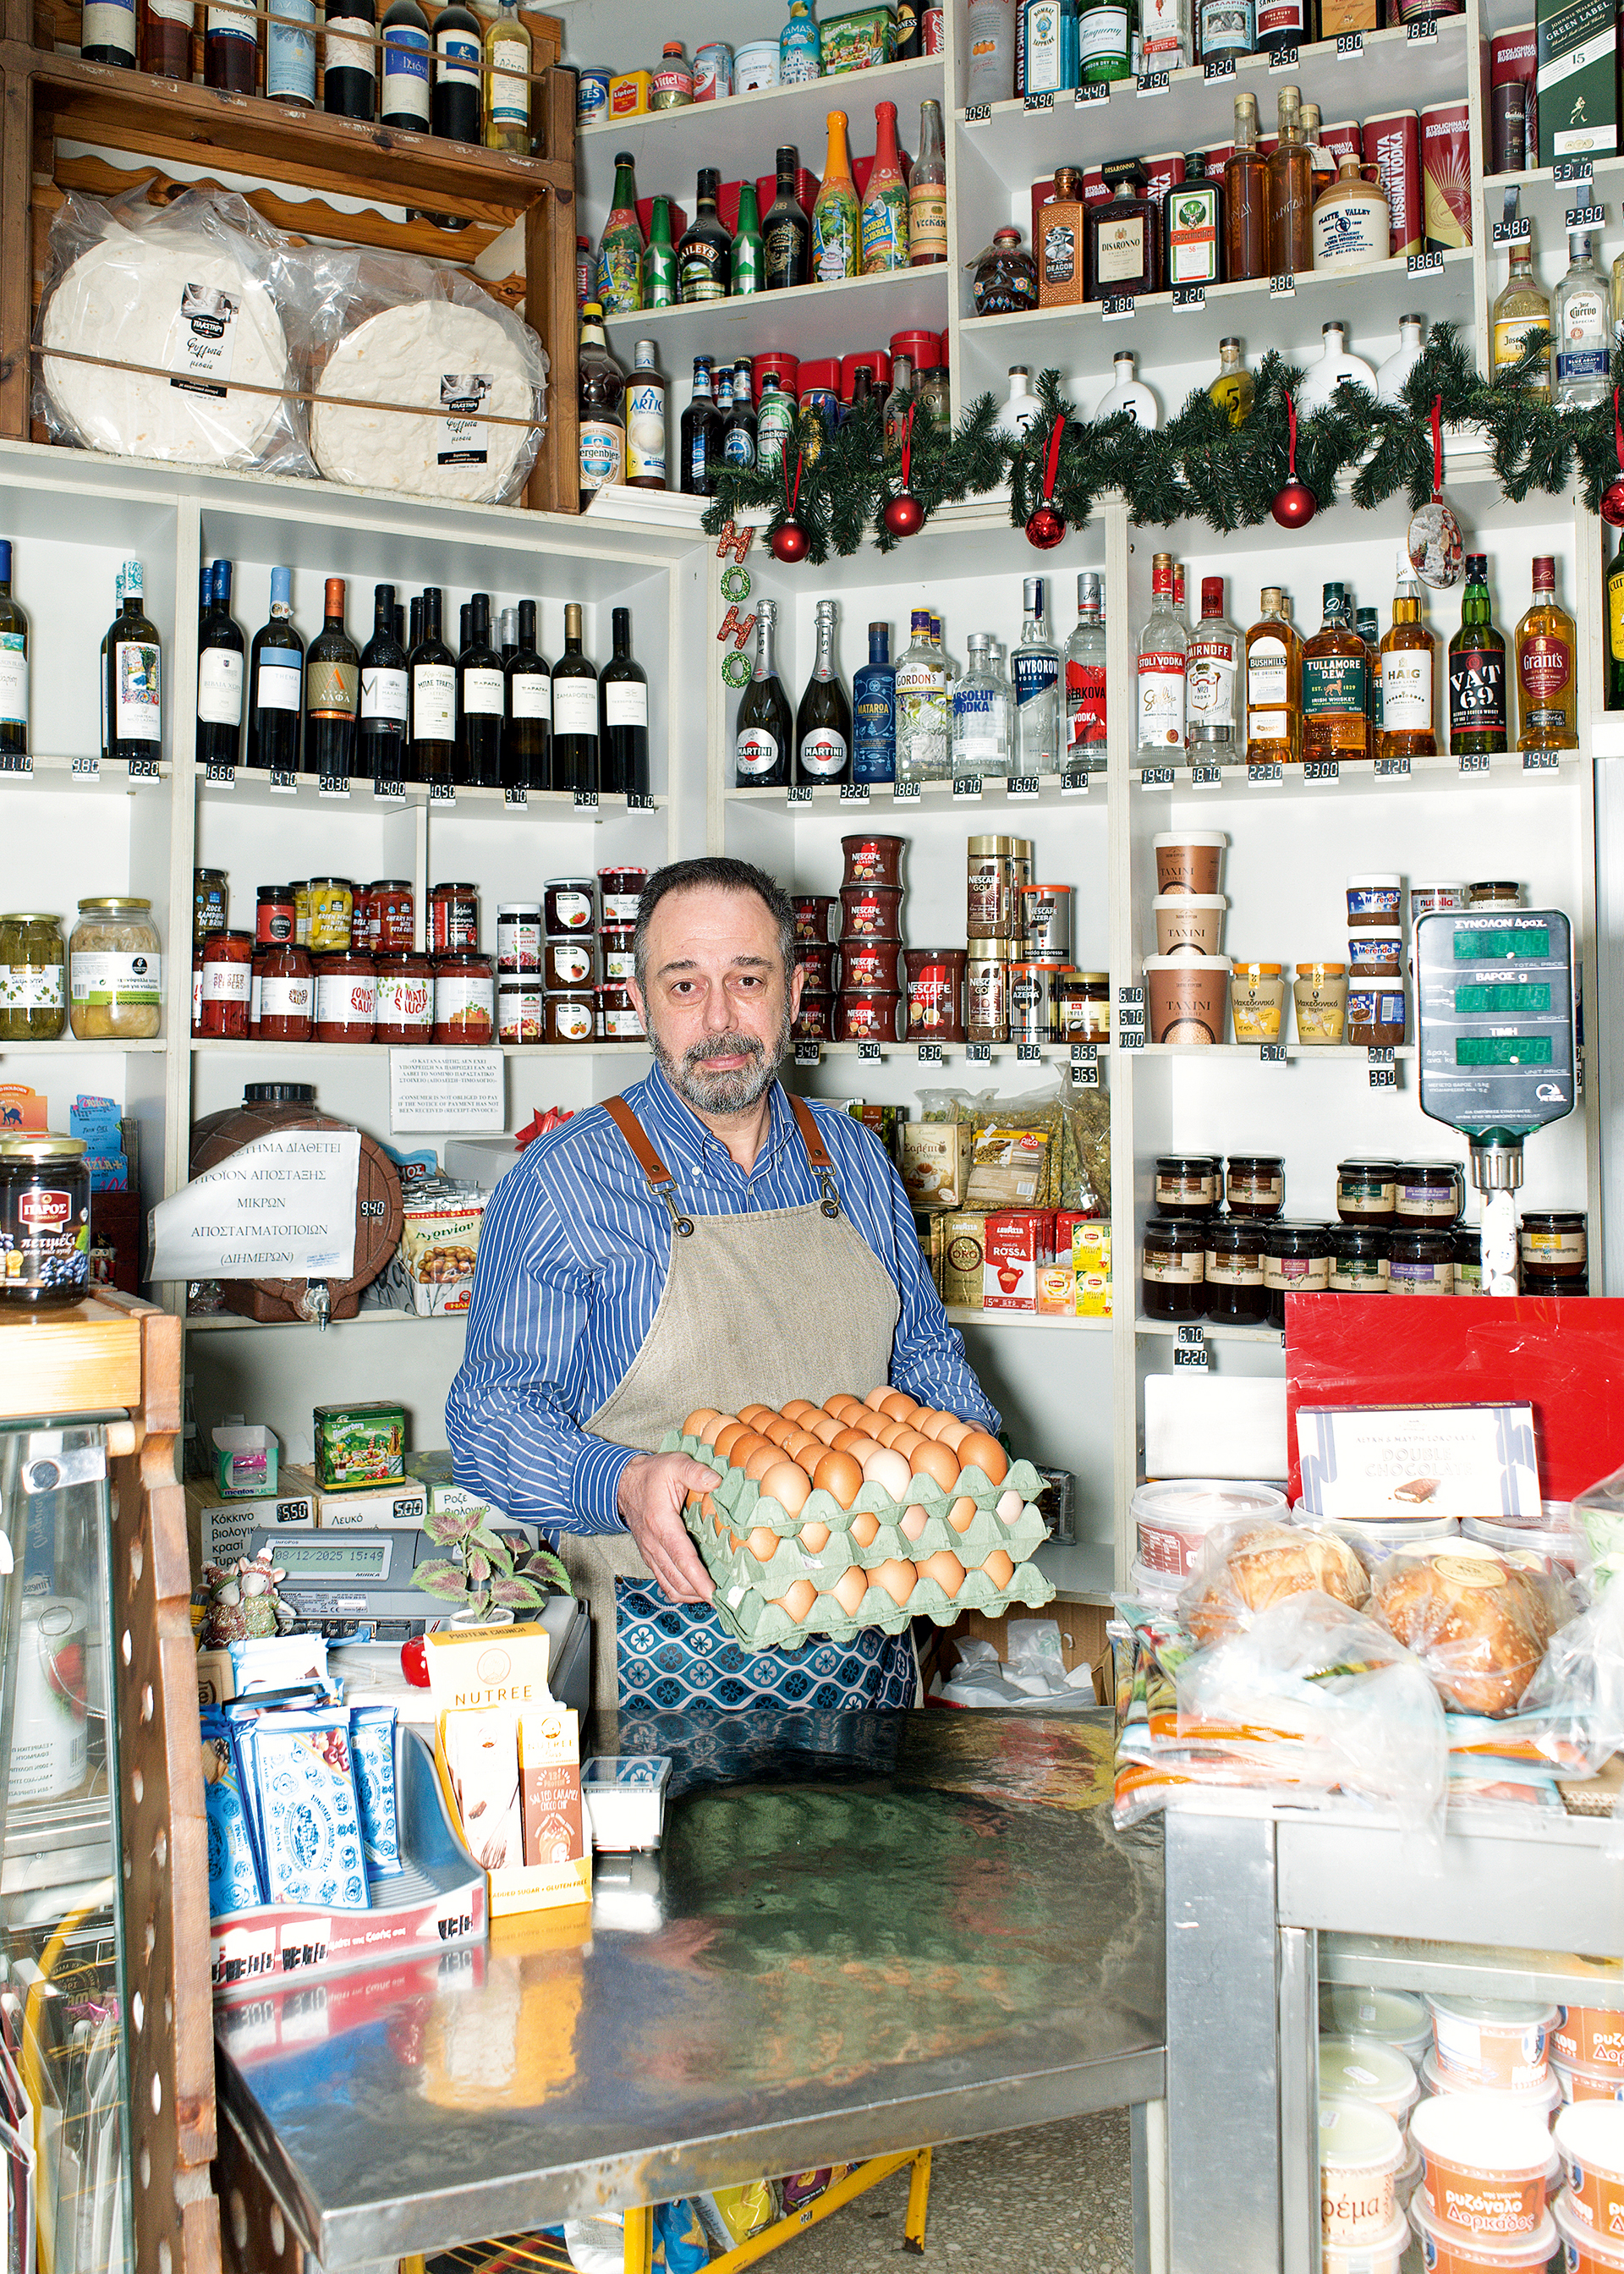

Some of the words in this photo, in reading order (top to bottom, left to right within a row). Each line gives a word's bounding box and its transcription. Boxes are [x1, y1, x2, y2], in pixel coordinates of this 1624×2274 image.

[1034, 8, 1056, 18] BOMBAY
[1082, 26, 1122, 41] Tanqueray
[1546, 20, 1577, 41] GREEN
[1205, 60, 1233, 77] 13,20
[656, 74, 678, 87] Vittel
[1138, 74, 1169, 90] 21,90
[614, 88, 635, 98] Lipton
[1076, 85, 1106, 102] 24,40
[1024, 95, 1054, 110] 24,90
[966, 105, 990, 120] 10,90
[1391, 131, 1403, 180] VODKA
[1392, 182, 1405, 228] RUSSIAN
[1319, 211, 1340, 224] PLATTE
[1345, 208, 1370, 217] VALLEY
[1566, 206, 1603, 225] 23,90
[1494, 221, 1529, 239] 24,80
[1101, 239, 1140, 251] DISARONNO
[1046, 262, 1073, 272] DEACON
[1408, 253, 1442, 270] 38,60
[1270, 275, 1294, 291] 9,80
[1173, 288, 1204, 304] 21,20
[1103, 299, 1134, 313] 21,80
[1570, 307, 1596, 319] Cuervo
[1226, 387, 1239, 412] 5
[820, 624, 829, 656] ASTI
[1138, 656, 1155, 668] STOLI
[1158, 656, 1183, 667] VODKA
[1250, 656, 1287, 667] BUSHMILLS
[1307, 660, 1361, 670] TULLAMORE
[1388, 670, 1421, 679] HAIG
[1450, 665, 1500, 689] VAT
[418, 680, 435, 690] ΜΠΛΕ
[1073, 712, 1095, 722] VODKA
[738, 746, 771, 756] MARTINI
[805, 746, 842, 757] MARTINI
[1525, 752, 1559, 766] 19,40
[73, 760, 100, 772] 9,80
[130, 762, 159, 775] 12,20
[1305, 763, 1339, 777] 23,00
[206, 766, 234, 780] 16,60
[1143, 769, 1173, 783] 19,40
[378, 783, 404, 795] 14,00
[431, 785, 455, 798] 10,50
[895, 783, 920, 796] 18,80
[1009, 778, 1039, 792] 16,00
[574, 793, 598, 805] 14,30
[630, 795, 654, 808] 17,10
[1455, 919, 1512, 929] ΣΥΝΟΛΟΝ
[1515, 919, 1547, 927] Δραχ.
[1358, 945, 1392, 955] Merenda
[1476, 972, 1515, 980] ΒΑΡΟΣ
[1518, 974, 1527, 982] g
[1234, 999, 1275, 1008] Μακεδονικό
[1297, 999, 1338, 1008] Μακεδονικό
[1120, 1010, 1143, 1024] 5,70
[919, 1046, 941, 1059] 9,30
[1072, 1046, 1096, 1059] 3,65
[286, 1142, 343, 1154] ΔΙΑΘΕΤΕΙ
[250, 1170, 326, 1180] ΑΠΟΣΤΑΞΗΣ
[237, 1198, 286, 1208] ΜΙΚΡΩΝ
[361, 1202, 384, 1216] 9,40
[25, 1205, 67, 1215] ΠΑΡΟΣ
[191, 1225, 328, 1237] ΑΠΟΣΤΑΓΜΑΤΟΠΟΙΩΝ
[996, 1225, 1023, 1234] LAVAZZA
[21, 1233, 76, 1249] πετιμέζι
[221, 1252, 294, 1266] (ΔΙΗΜΕΡΩΝ)
[1179, 1327, 1202, 1343] 6,70
[332, 1423, 365, 1439] Underberg
[211, 1513, 254, 1524] Κόκκινο
[332, 1515, 363, 1524] Λευκό
[212, 1541, 243, 1552] κρασί
[276, 1551, 343, 1560] 08/12/2025
[351, 1551, 383, 1560] 15:49
[448, 1629, 486, 1640] PROTEIN
[490, 1626, 526, 1637] CRUNCH
[455, 1685, 532, 1706] NUTREE
[529, 1789, 551, 1804] SALTED
[540, 1800, 557, 1811] CHOCO
[492, 1891, 515, 1899] ADDED
[517, 1889, 540, 1898] SUGAR
[546, 1884, 570, 1893] GLUTEN
[572, 1880, 588, 1889] FREE
[1446, 2190, 1522, 2213] ρυζόγαλο
[1447, 2204, 1534, 2233] Δορκάδος
